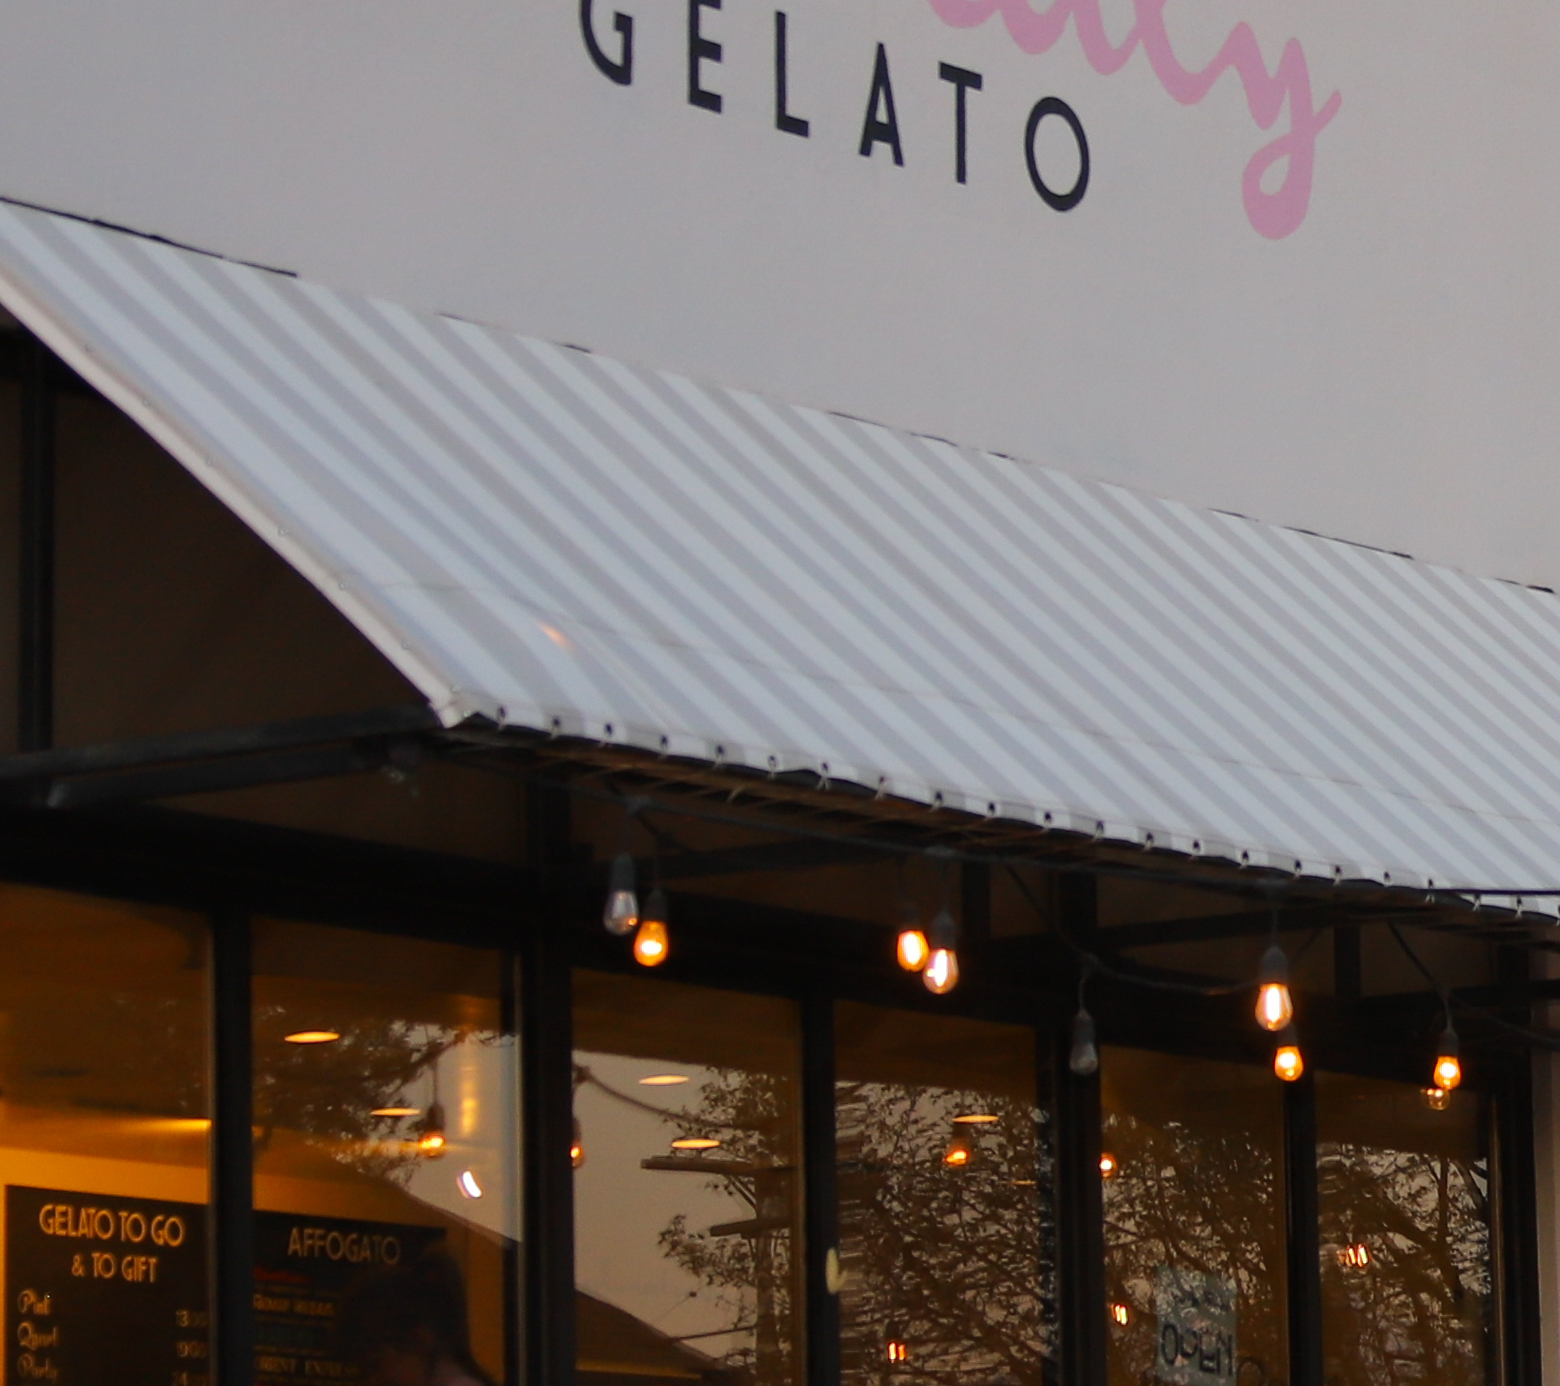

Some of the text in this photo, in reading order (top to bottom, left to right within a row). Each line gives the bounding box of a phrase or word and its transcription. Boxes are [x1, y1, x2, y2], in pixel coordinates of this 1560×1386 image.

[38, 1203, 186, 1248] GELATO TO GO
[287, 1226, 401, 1266] AFFOGATO
[71, 1251, 159, 1284] & TO GIFT
[17, 1287, 51, 1316] Pint
